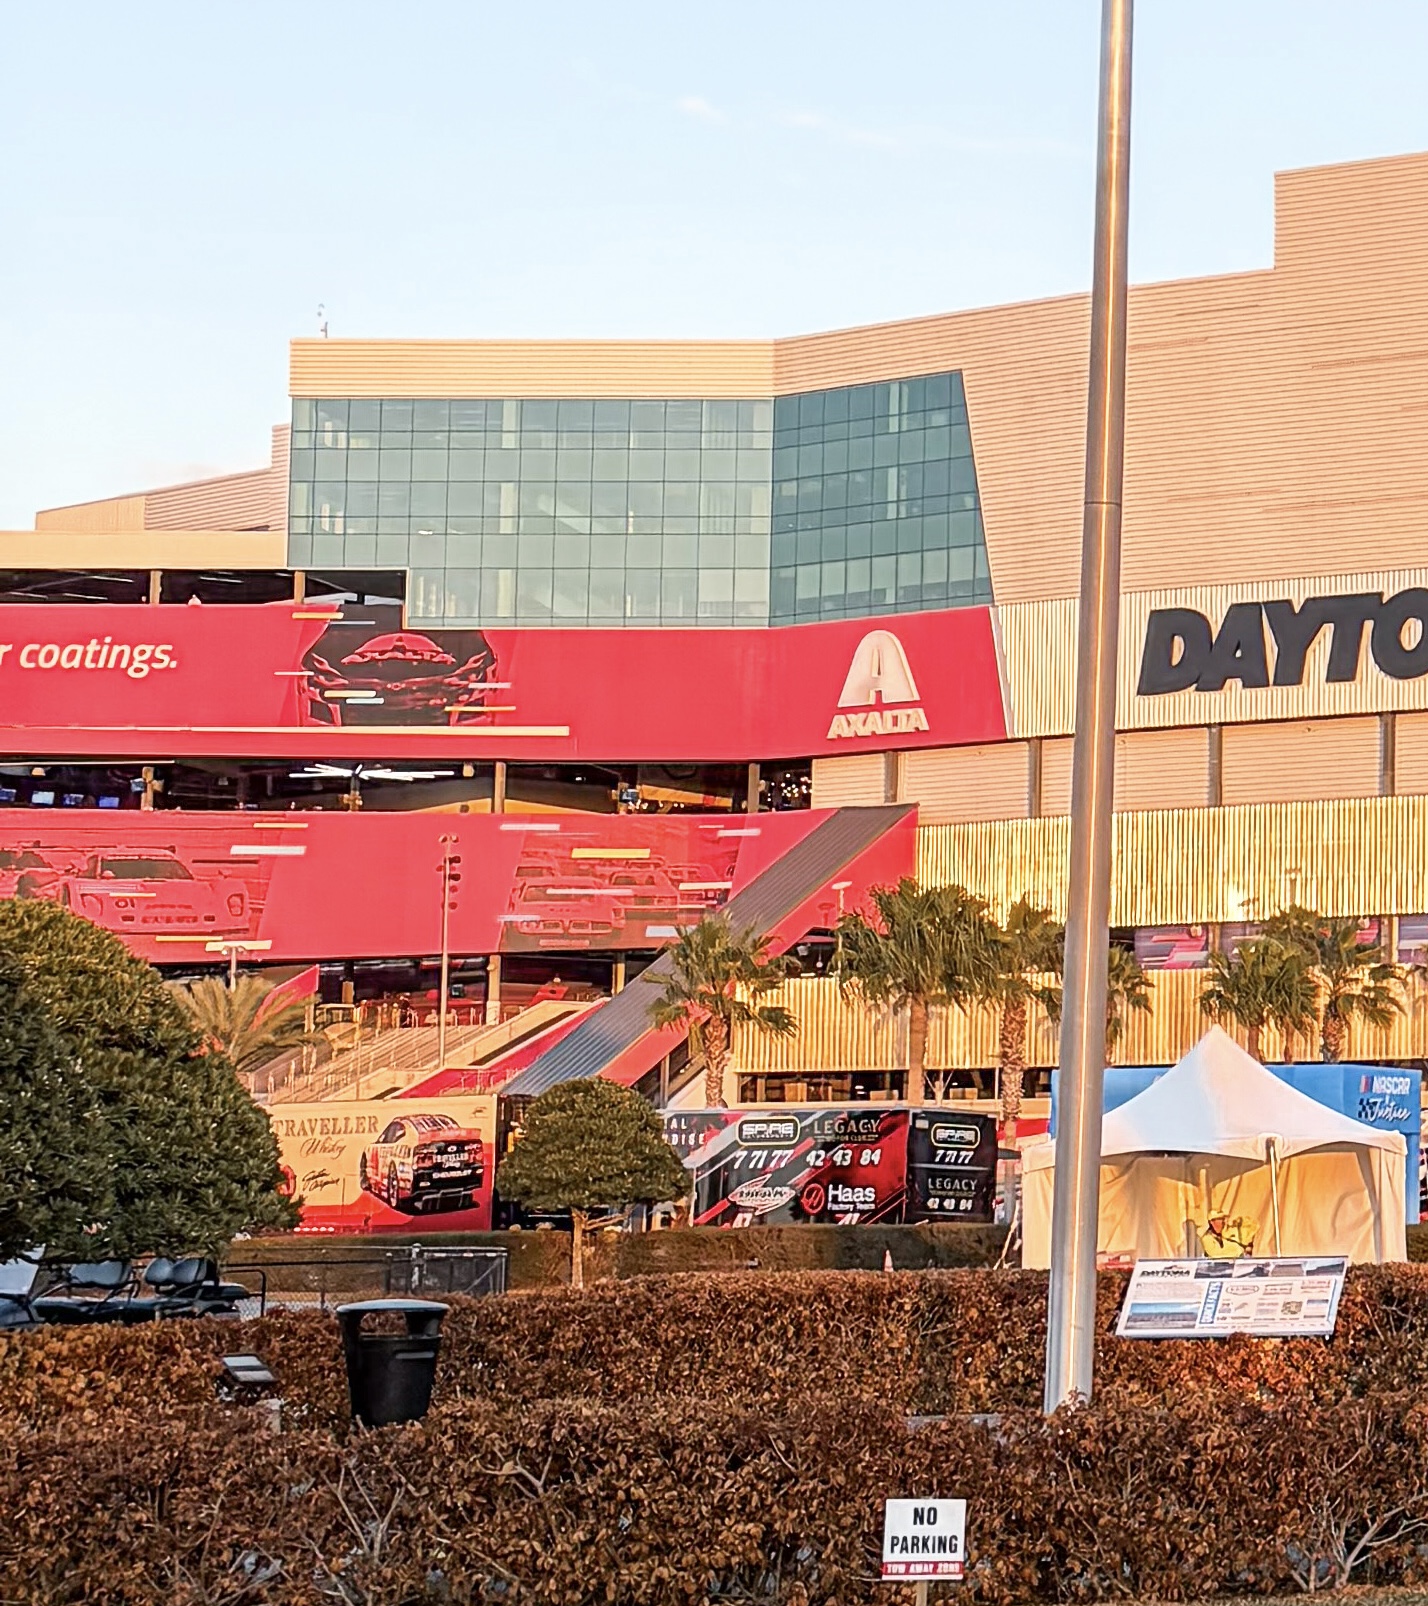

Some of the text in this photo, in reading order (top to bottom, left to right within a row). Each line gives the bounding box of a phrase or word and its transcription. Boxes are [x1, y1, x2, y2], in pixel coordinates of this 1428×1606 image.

[20, 636, 177, 679] coatings.
[826, 708, 930, 739] AXALTA
[1372, 1075, 1411, 1095] NASCAR
[273, 1115, 379, 1138] TRAVELLER
[814, 1119, 880, 1134] LEGACY
[733, 1149, 794, 1169] 7 71 77
[806, 1149, 882, 1167] 42 43 84
[828, 1184, 876, 1202] Haas
[928, 1178, 978, 1191] LEGACY
[913, 1507, 938, 1526] NO
[890, 1535, 958, 1554] PARKING
[887, 1562, 960, 1574] TOW AWAY ZONE
